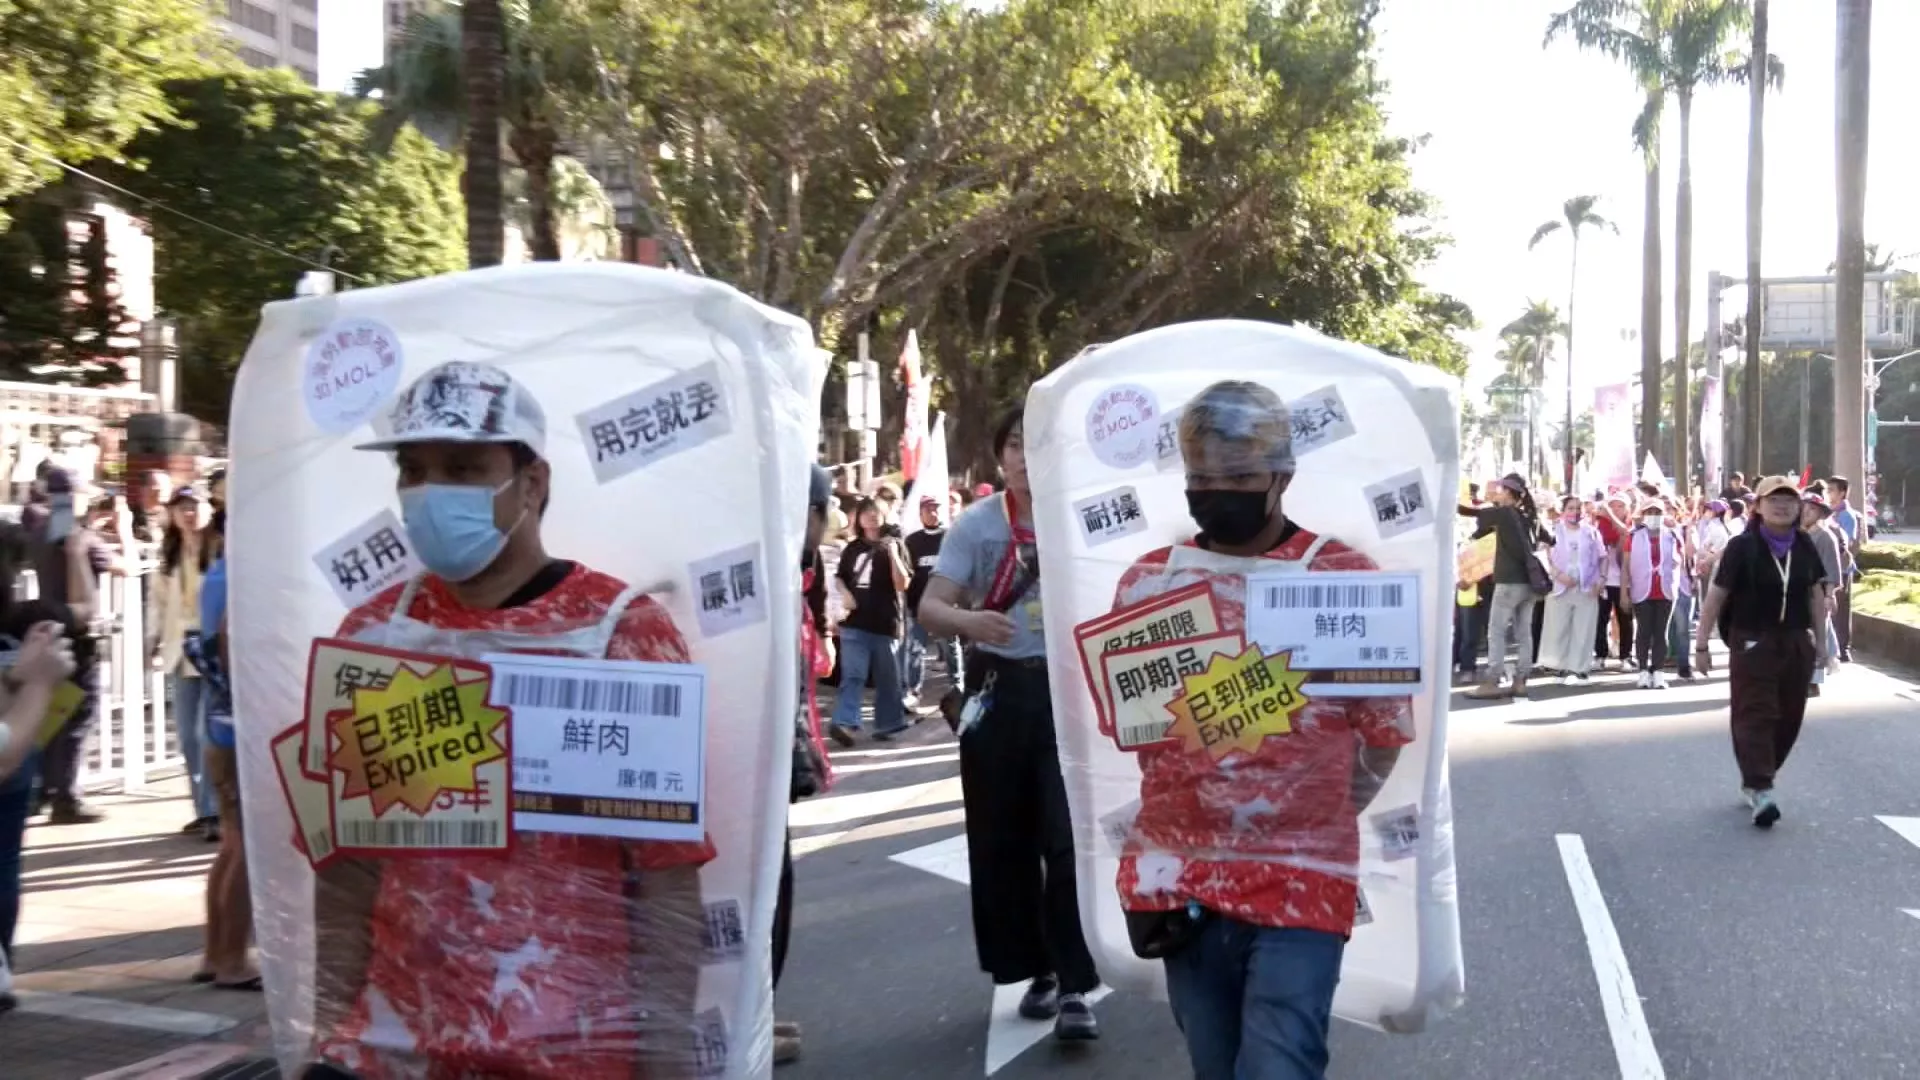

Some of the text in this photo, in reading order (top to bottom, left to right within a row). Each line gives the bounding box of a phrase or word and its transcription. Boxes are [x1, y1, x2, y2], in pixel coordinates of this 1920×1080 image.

[335, 362, 377, 392] MOL
[1080, 493, 1140, 533] 耐操
[330, 527, 407, 592] 好用
[700, 560, 756, 612] 廉價
[1102, 608, 1197, 653] 保存期限
[1314, 613, 1367, 639] 鮮肉
[1115, 647, 1206, 703] 即期品
[1393, 647, 1409, 661] 元
[1186, 660, 1275, 723] 已到期
[1199, 683, 1295, 747] Expired
[353, 685, 465, 757] 已到期
[561, 718, 629, 757] 鮮肉
[362, 720, 486, 790] Expired
[617, 768, 684, 792] 廉價 元
